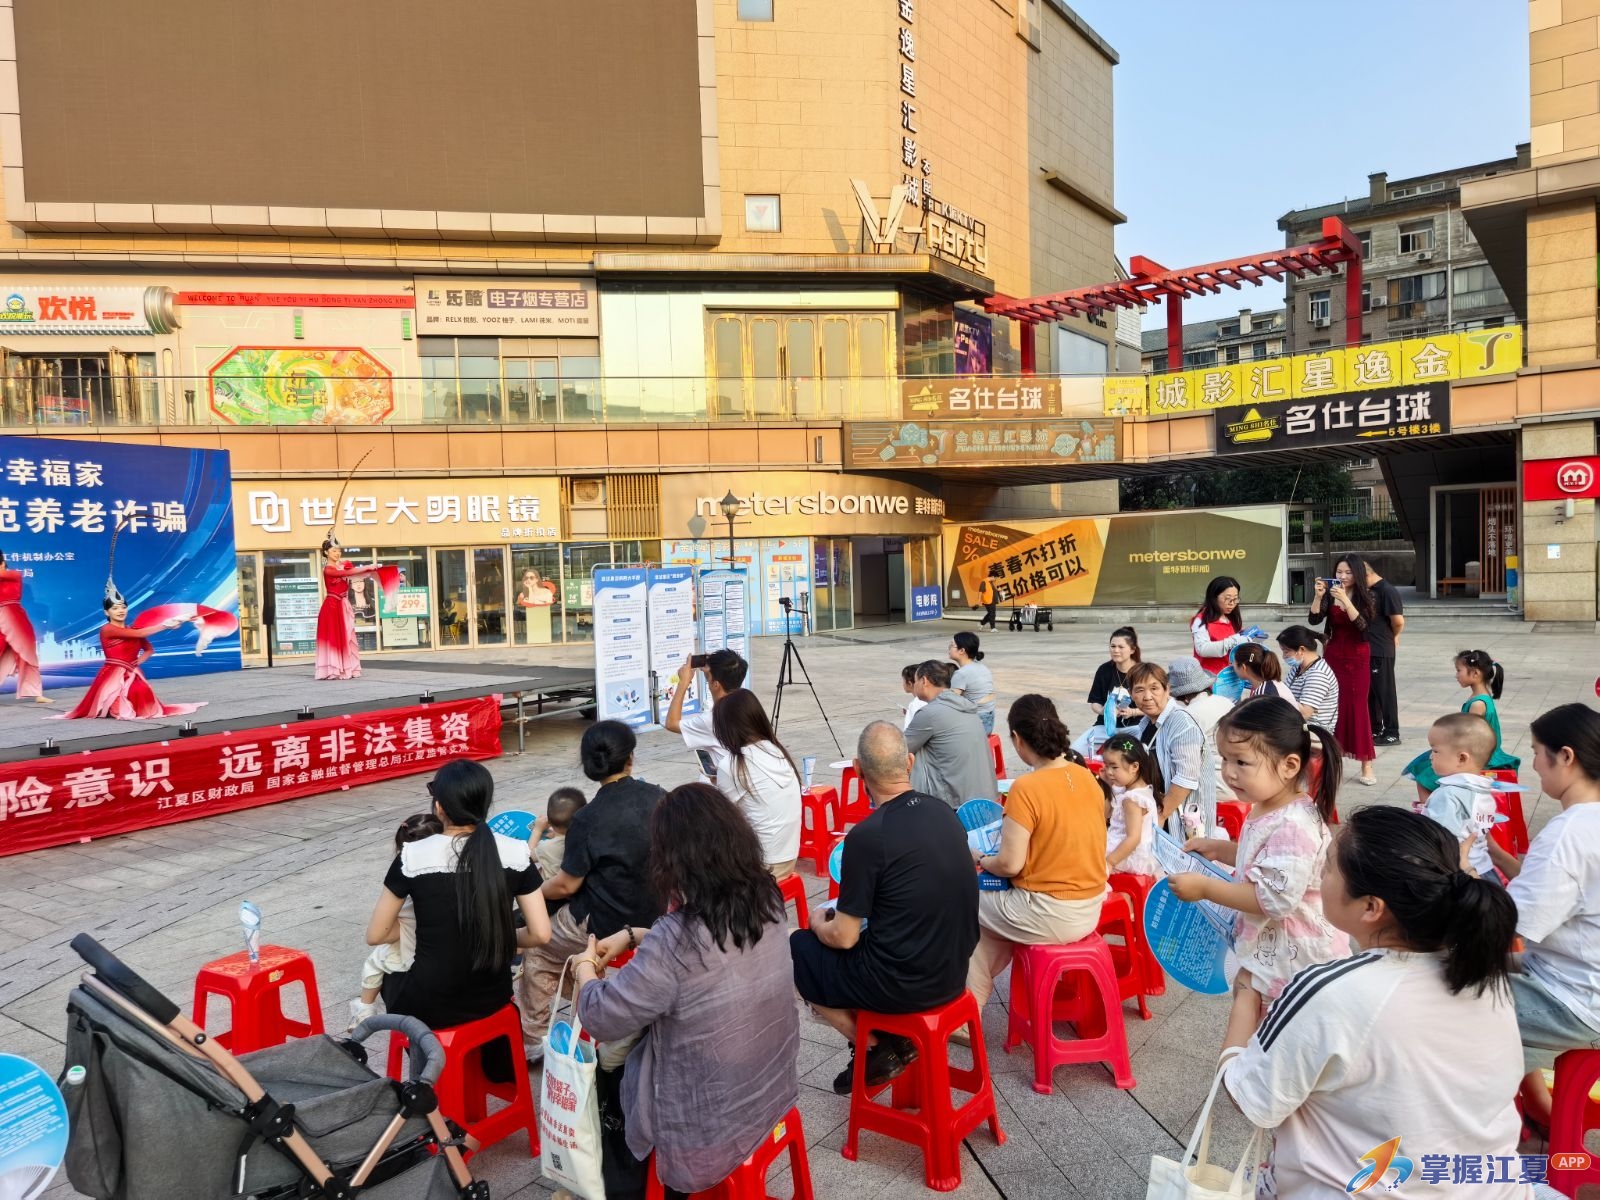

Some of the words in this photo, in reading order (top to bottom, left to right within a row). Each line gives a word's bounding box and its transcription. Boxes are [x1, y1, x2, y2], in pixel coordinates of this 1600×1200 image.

[38, 295, 98, 321] 欢悦
[490, 291, 586, 307] 电子烟专营店
[949, 387, 1042, 410] 名仕台球
[1285, 391, 1432, 435] 名仕台球
[955, 429, 1049, 444] 金逸星汇影城
[1229, 424, 1249, 433] MING
[1388, 423, 1441, 437] 5号楼3楼
[0, 458, 104, 488] 幸福家
[300, 495, 540, 524] 世纪大明眼镜
[915, 497, 945, 516] 美特斯邦
[501, 527, 557, 538] 品牌折扣店
[964, 533, 999, 550] SALE
[988, 533, 1077, 579] 青春不打折
[1129, 549, 1246, 563] metersbonwe
[401, 599, 420, 610] 299
[915, 593, 938, 608] 电影院
[0, 757, 174, 821] 险意识
[218, 711, 471, 781] 远离非法集资
[157, 782, 255, 809] 江夏区财政局
